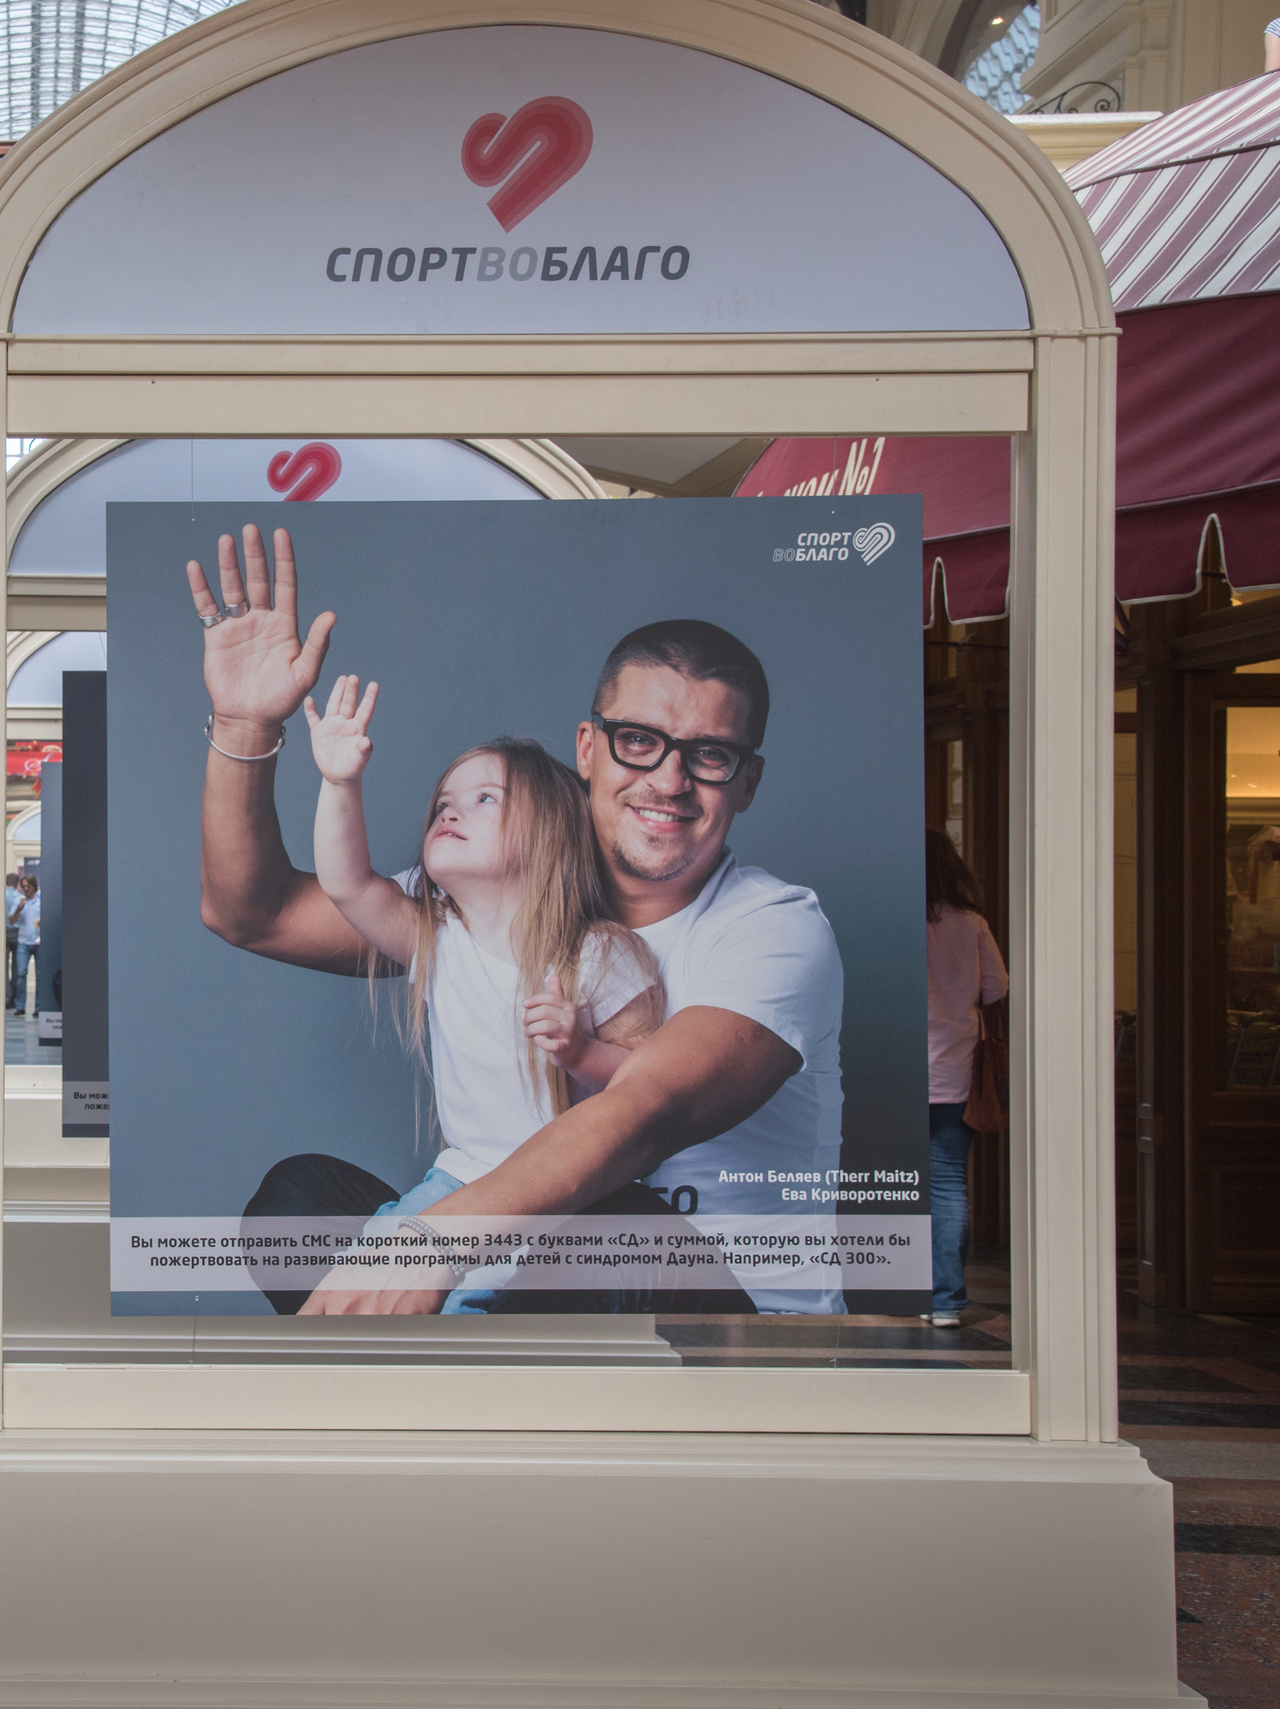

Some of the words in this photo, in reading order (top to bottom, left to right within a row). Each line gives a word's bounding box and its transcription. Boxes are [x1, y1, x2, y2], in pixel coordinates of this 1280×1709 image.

[325, 244, 691, 283] СПОРТВОБЛАГО
[797, 532, 852, 546] СПОРТ
[773, 547, 849, 562] ВОБЛАГО
[73, 1091, 87, 1100] Вы
[88, 1092, 110, 1100] мож
[719, 1170, 764, 1183] Антон
[768, 1170, 821, 1183] Беляев
[825, 1169, 870, 1185] (Therr
[874, 1169, 920, 1185] Maitz)
[782, 1188, 807, 1201] Ева
[811, 1188, 920, 1204] Криворотенко
[130, 1236, 152, 1248] Вы
[158, 1236, 216, 1248] можете
[220, 1236, 298, 1250] отправить
[302, 1234, 331, 1248] СМС
[335, 1236, 353, 1247] на
[358, 1234, 428, 1250] короткий
[432, 1236, 480, 1249] номер
[484, 1234, 522, 1247] 3443
[526, 1236, 534, 1246] с
[538, 1233, 603, 1248] буквами
[607, 1233, 650, 1248] «СД»
[654, 1234, 664, 1246] и
[667, 1232, 729, 1248] суммой,
[733, 1234, 800, 1248] которую
[804, 1234, 826, 1246] вы
[830, 1234, 884, 1246] хотели
[888, 1233, 911, 1246] бы
[150, 1255, 258, 1269] пожертвовать
[262, 1255, 280, 1266] на
[284, 1254, 390, 1268] развивающие
[394, 1254, 480, 1268] программы
[484, 1254, 512, 1266] для
[516, 1252, 561, 1266] детей
[564, 1254, 572, 1264] с
[576, 1253, 662, 1267] синдромом
[666, 1252, 719, 1267] Дауна.
[723, 1252, 805, 1267] Например,
[809, 1252, 842, 1266] «СД
[846, 1252, 892, 1265] 300».
